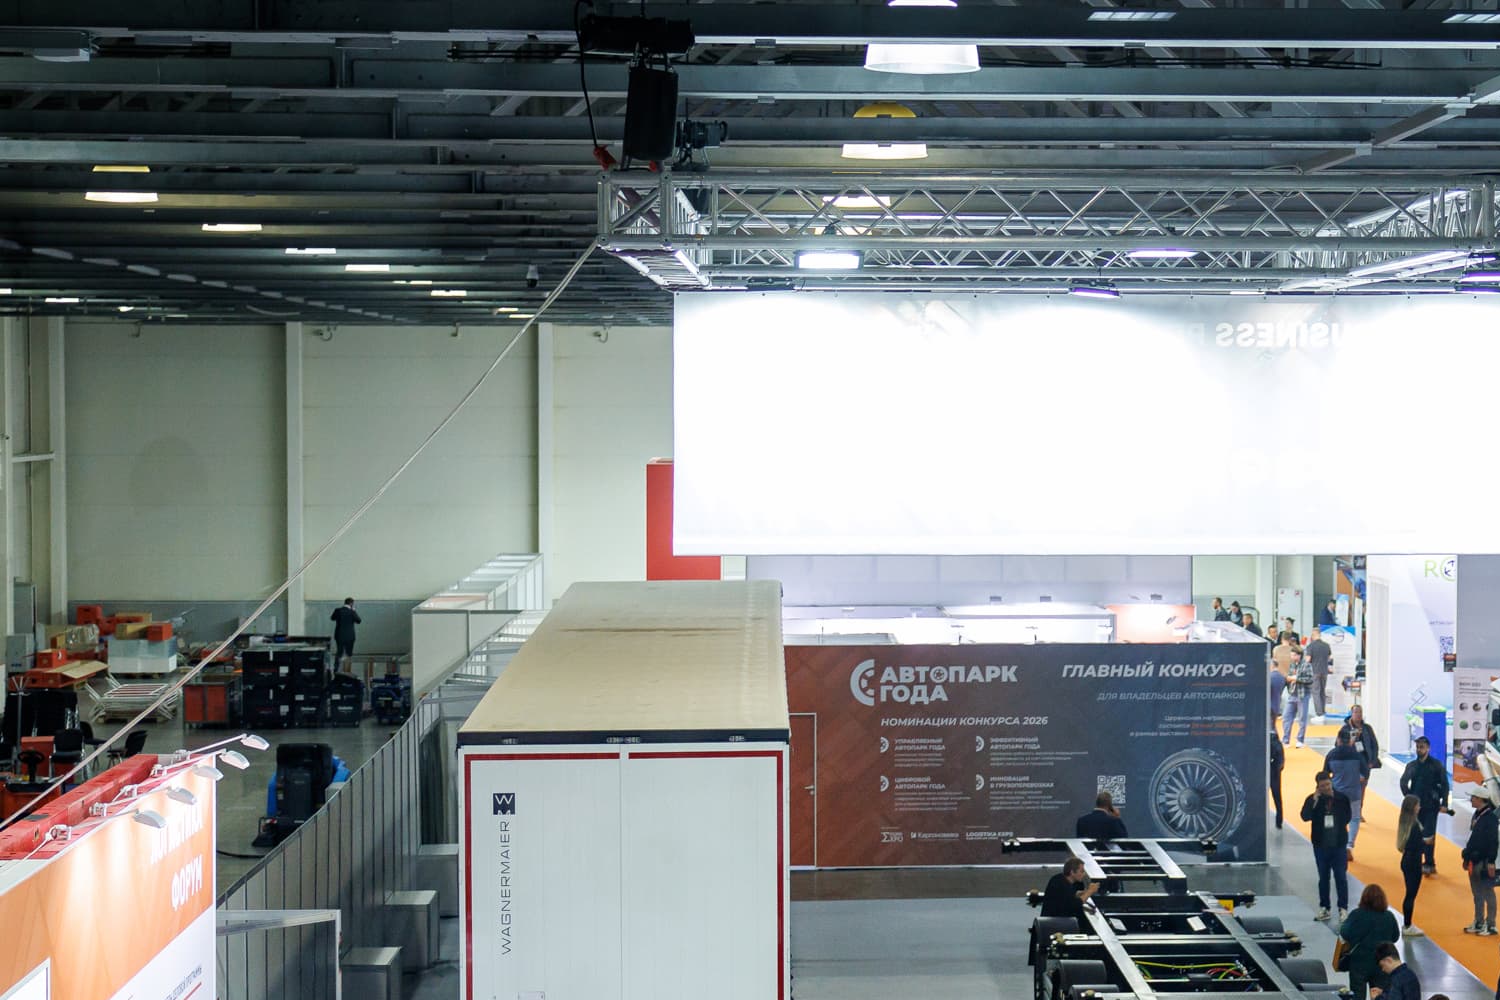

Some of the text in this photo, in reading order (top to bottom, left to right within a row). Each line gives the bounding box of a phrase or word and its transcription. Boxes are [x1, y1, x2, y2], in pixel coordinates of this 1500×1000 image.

[880, 666, 1018, 683] АВТОПАРК
[1062, 661, 1247, 678] ГЛАВНЫЙ КОНКУРС
[880, 685, 949, 705] ГОДА
[1119, 693, 1182, 701] ВЛАДЕЛЬЦЕВ
[1183, 692, 1246, 700] АВТОПАРКОВ
[881, 716, 1049, 728] НОМИНАЦИИ КОНКУРСА 2026
[171, 854, 203, 911] ФОРУМ
[501, 820, 511, 955] WAGNERMAIER
